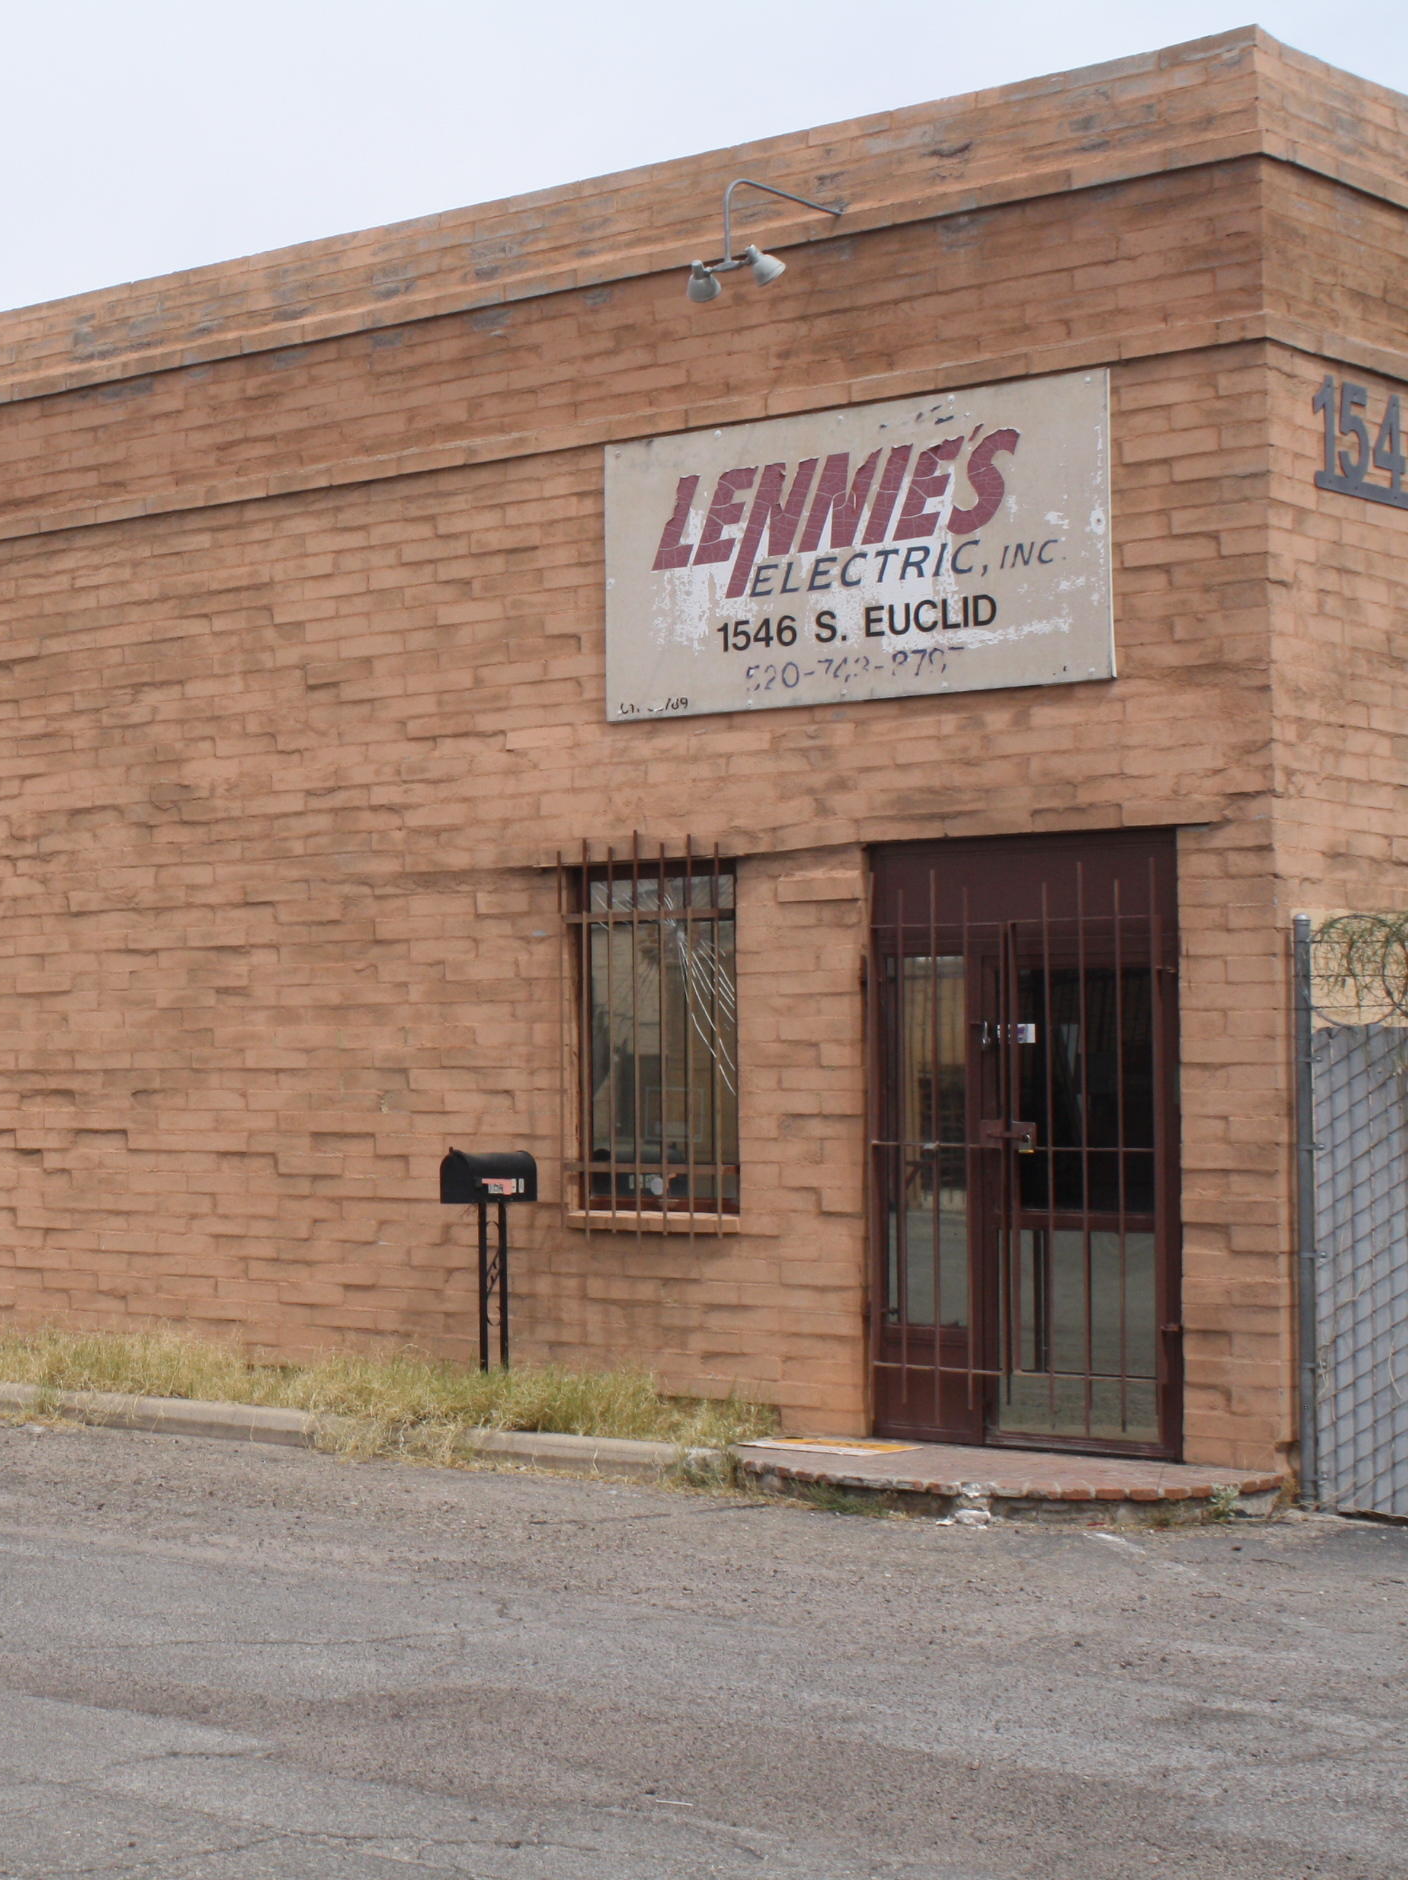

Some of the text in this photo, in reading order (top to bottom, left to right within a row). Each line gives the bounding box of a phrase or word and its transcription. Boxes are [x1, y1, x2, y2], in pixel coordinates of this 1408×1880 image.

[651, 423, 1021, 600] LENNIE'S
[717, 593, 998, 653] 1546 S. EUCLID
